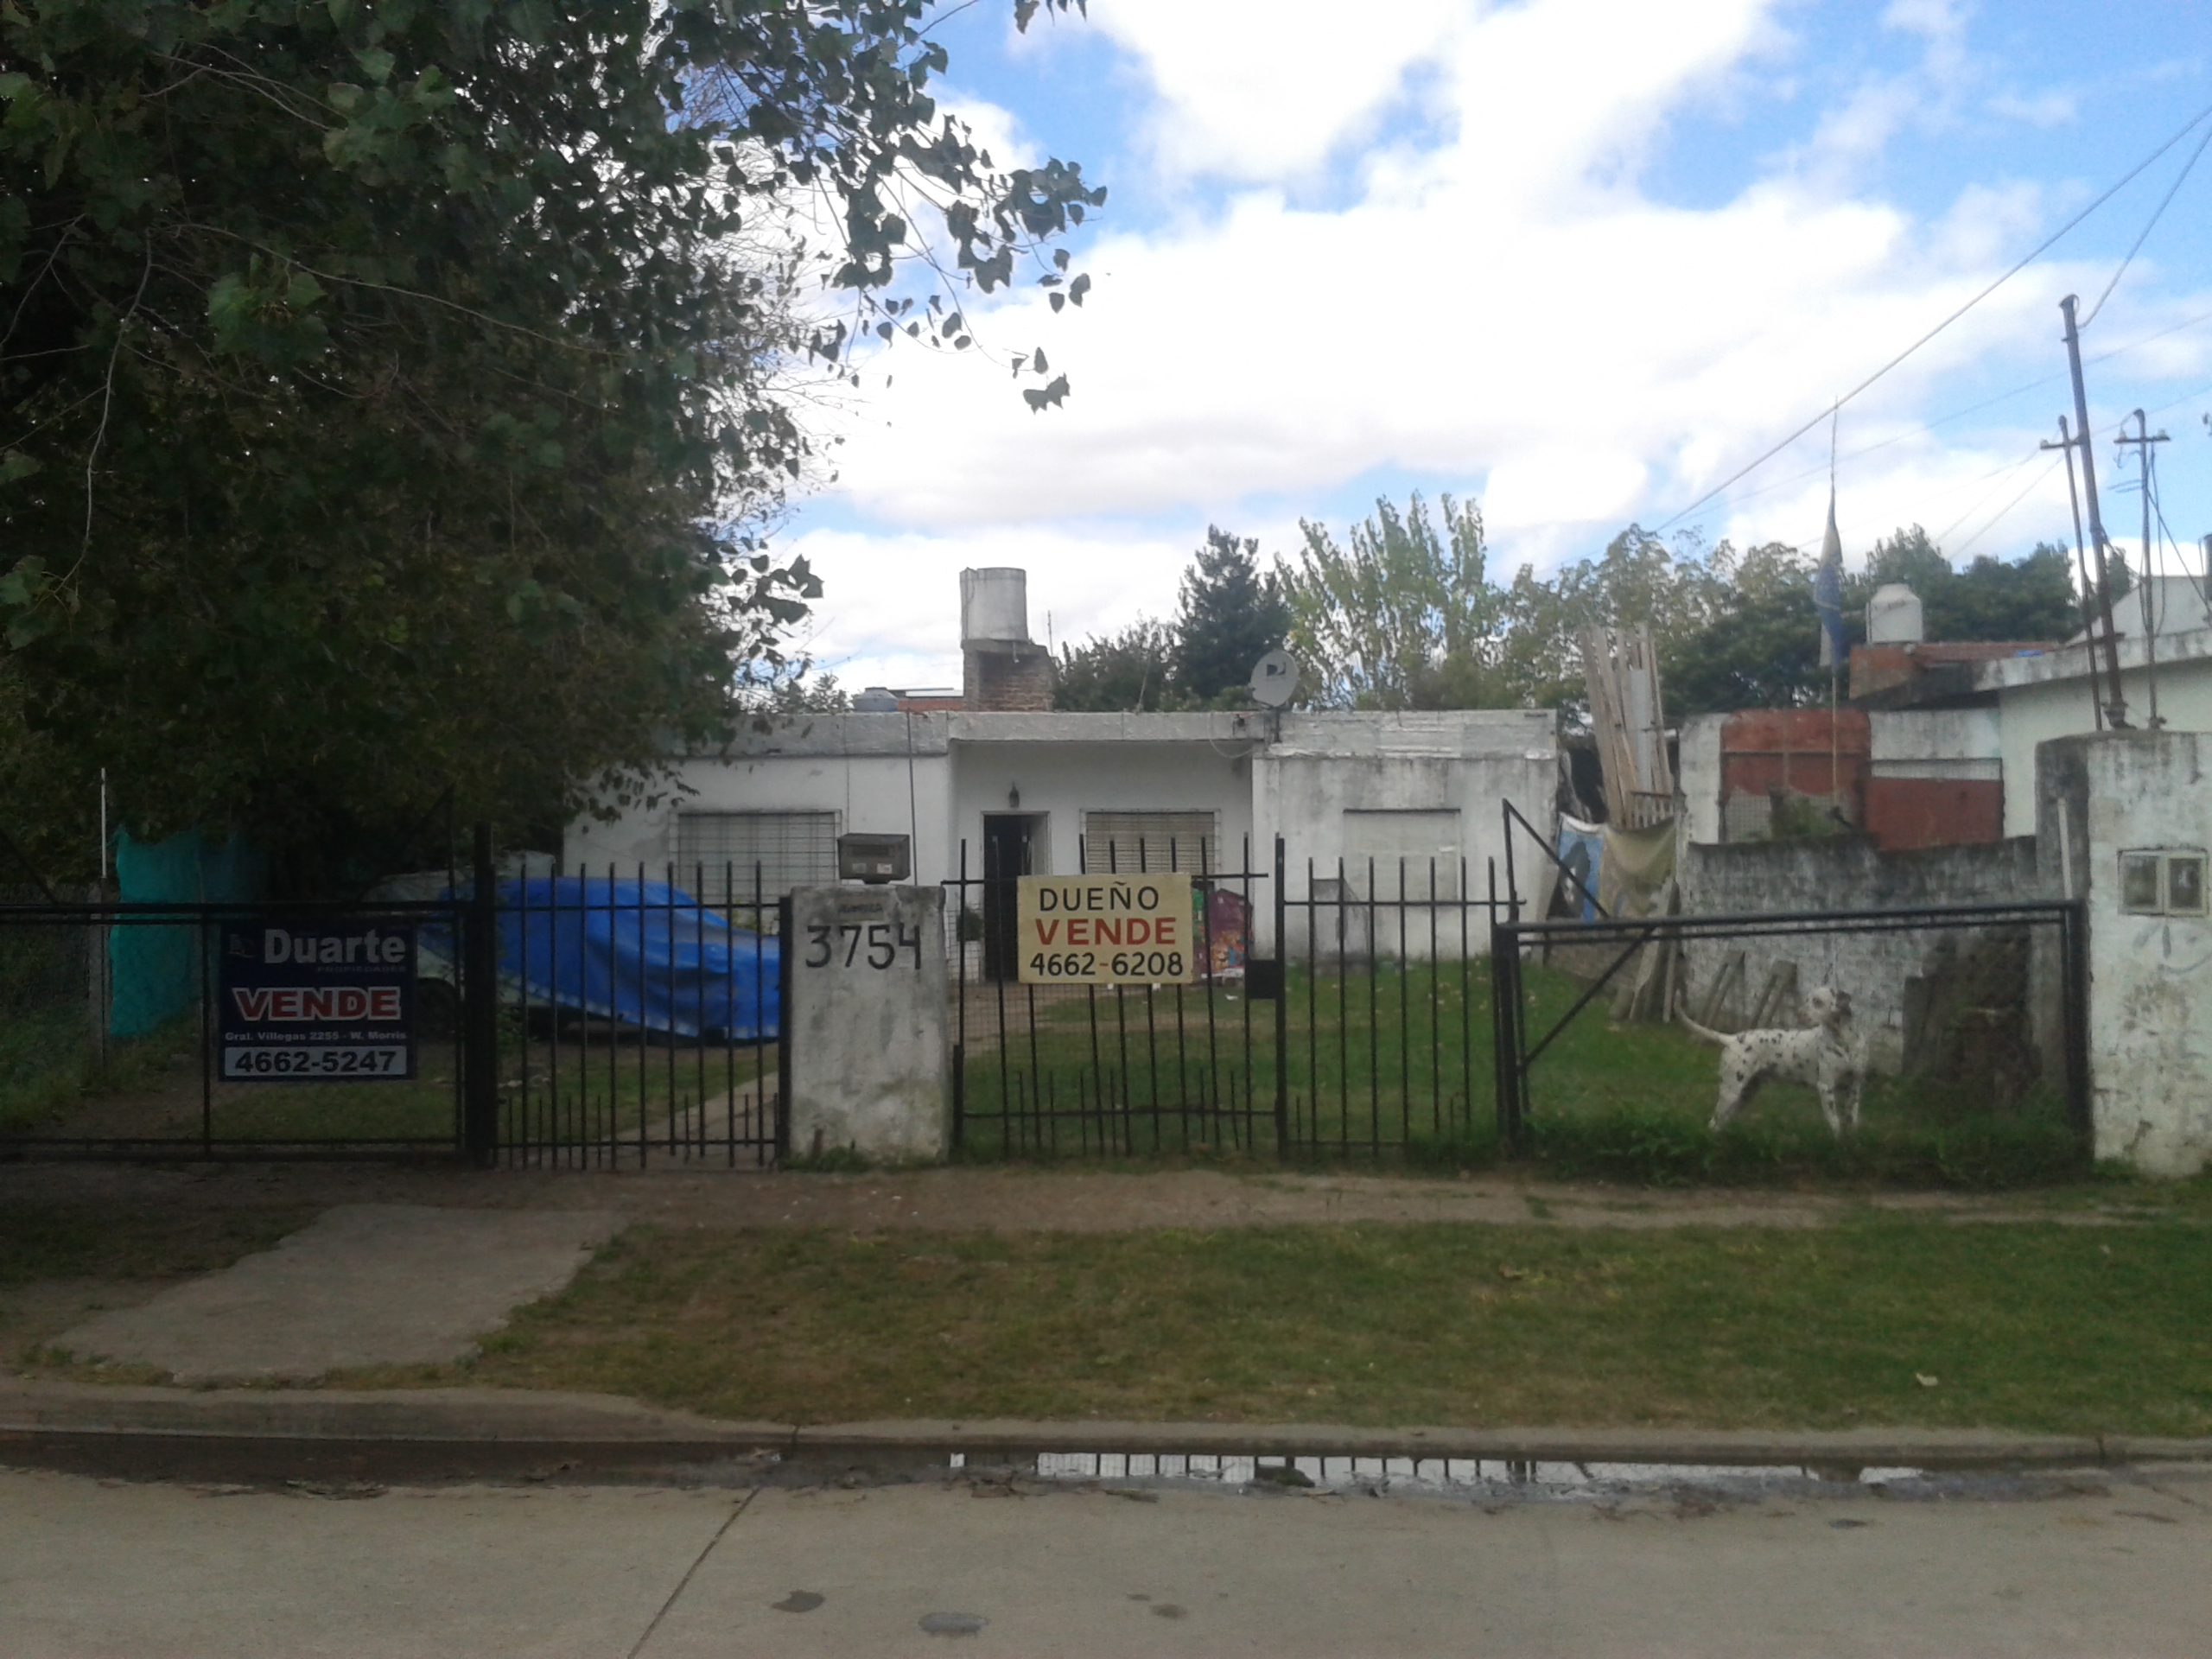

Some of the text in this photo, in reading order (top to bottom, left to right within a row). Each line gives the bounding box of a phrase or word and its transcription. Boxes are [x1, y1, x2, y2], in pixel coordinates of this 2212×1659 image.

[1039, 880, 1159, 912] DUEÑO
[264, 929, 406, 963] Duarte
[805, 922, 921, 969] 3754
[1035, 917, 1176, 945] VENDE
[1030, 951, 1183, 976] 4662-6208
[232, 986, 402, 1021] VENDE
[257, 1032, 307, 1042] Villegas
[368, 1030, 407, 1039] Morris
[235, 1051, 397, 1073] 4662-5247
